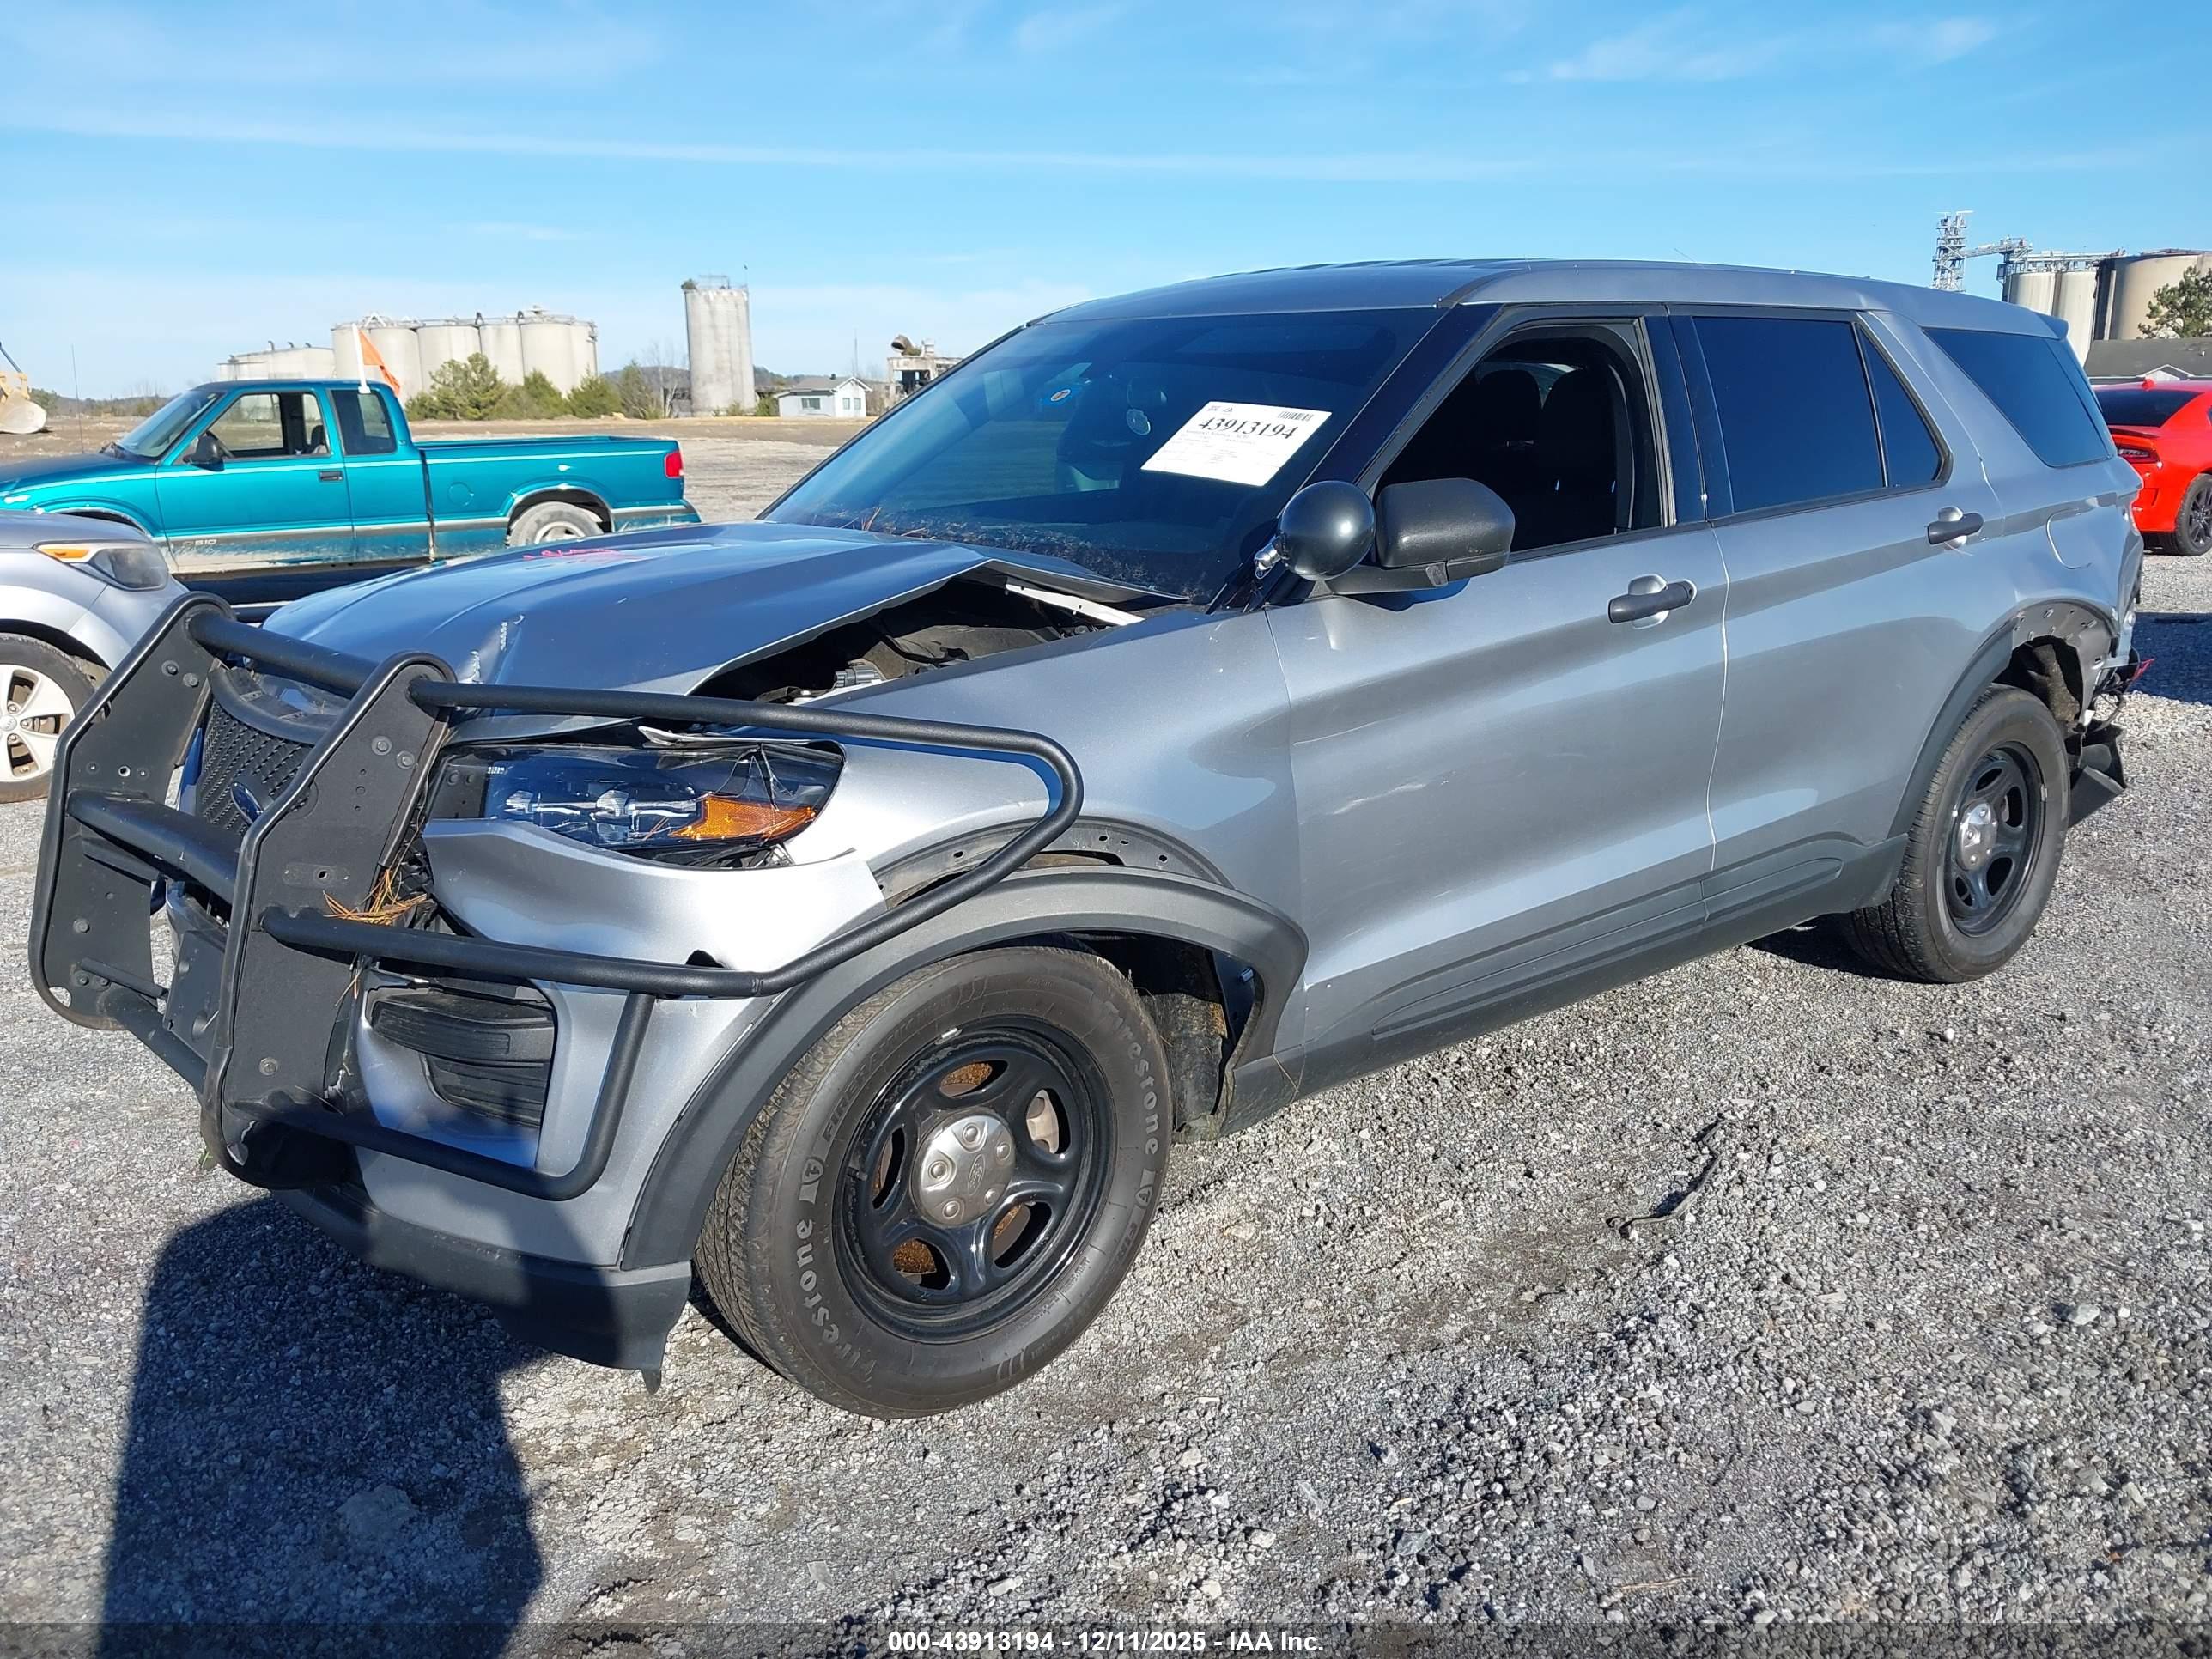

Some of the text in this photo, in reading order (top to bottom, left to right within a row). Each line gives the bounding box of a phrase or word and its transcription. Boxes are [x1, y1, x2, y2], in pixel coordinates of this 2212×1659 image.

[1199, 417, 1299, 440] 43913194
[1099, 1000, 1160, 1156] Firestone
[796, 1218, 877, 1383] Firestone
